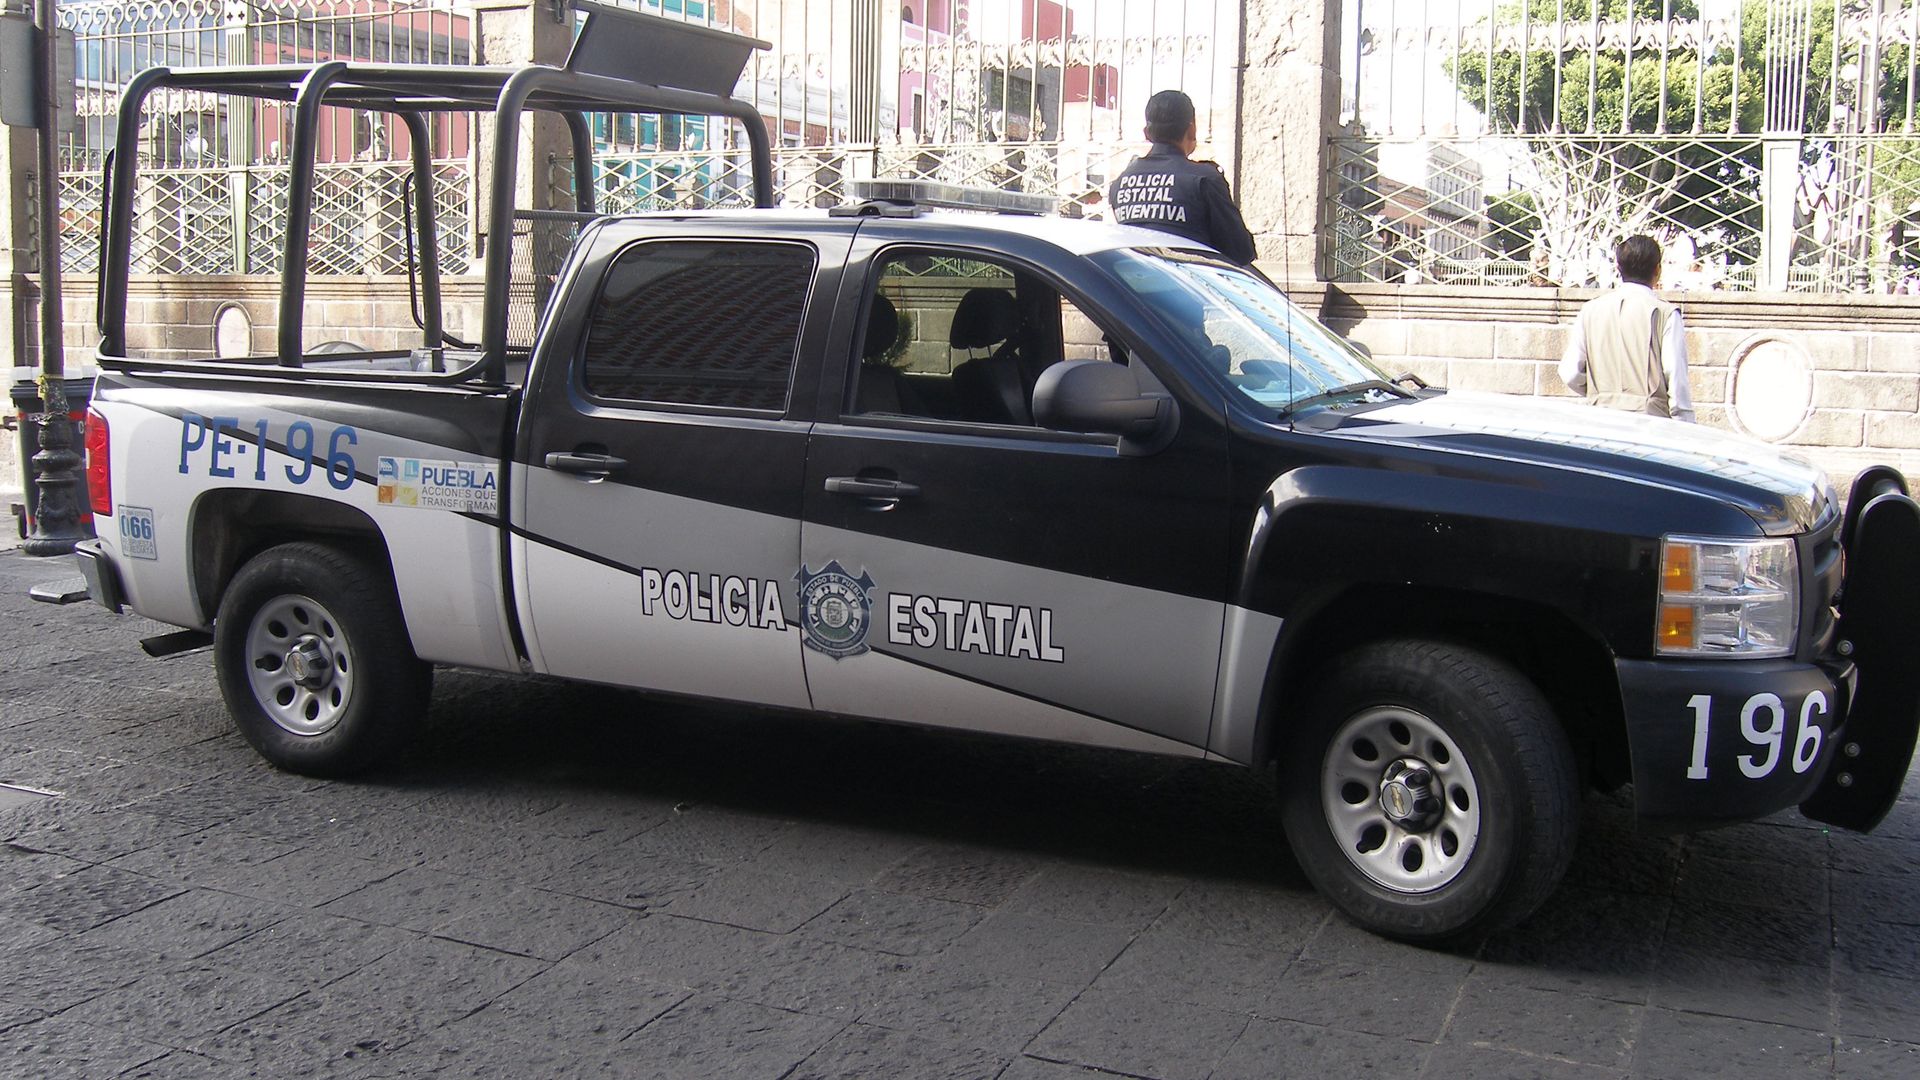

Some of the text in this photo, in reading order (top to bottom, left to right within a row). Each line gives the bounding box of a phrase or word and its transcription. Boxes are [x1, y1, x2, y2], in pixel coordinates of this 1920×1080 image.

[1120, 174, 1175, 188] POLICIA
[1116, 187, 1174, 204] ESTATAL
[421, 467, 497, 490] PUEBLA
[421, 486, 497, 500] ACCIONES QUE
[421, 496, 497, 511] TRANSFORMAN
[806, 576, 827, 597] ESTADO
[841, 578, 864, 602] PUEBLA
[640, 566, 1065, 663] POLICIA ESTATAL
[1686, 689, 1828, 780] 196
